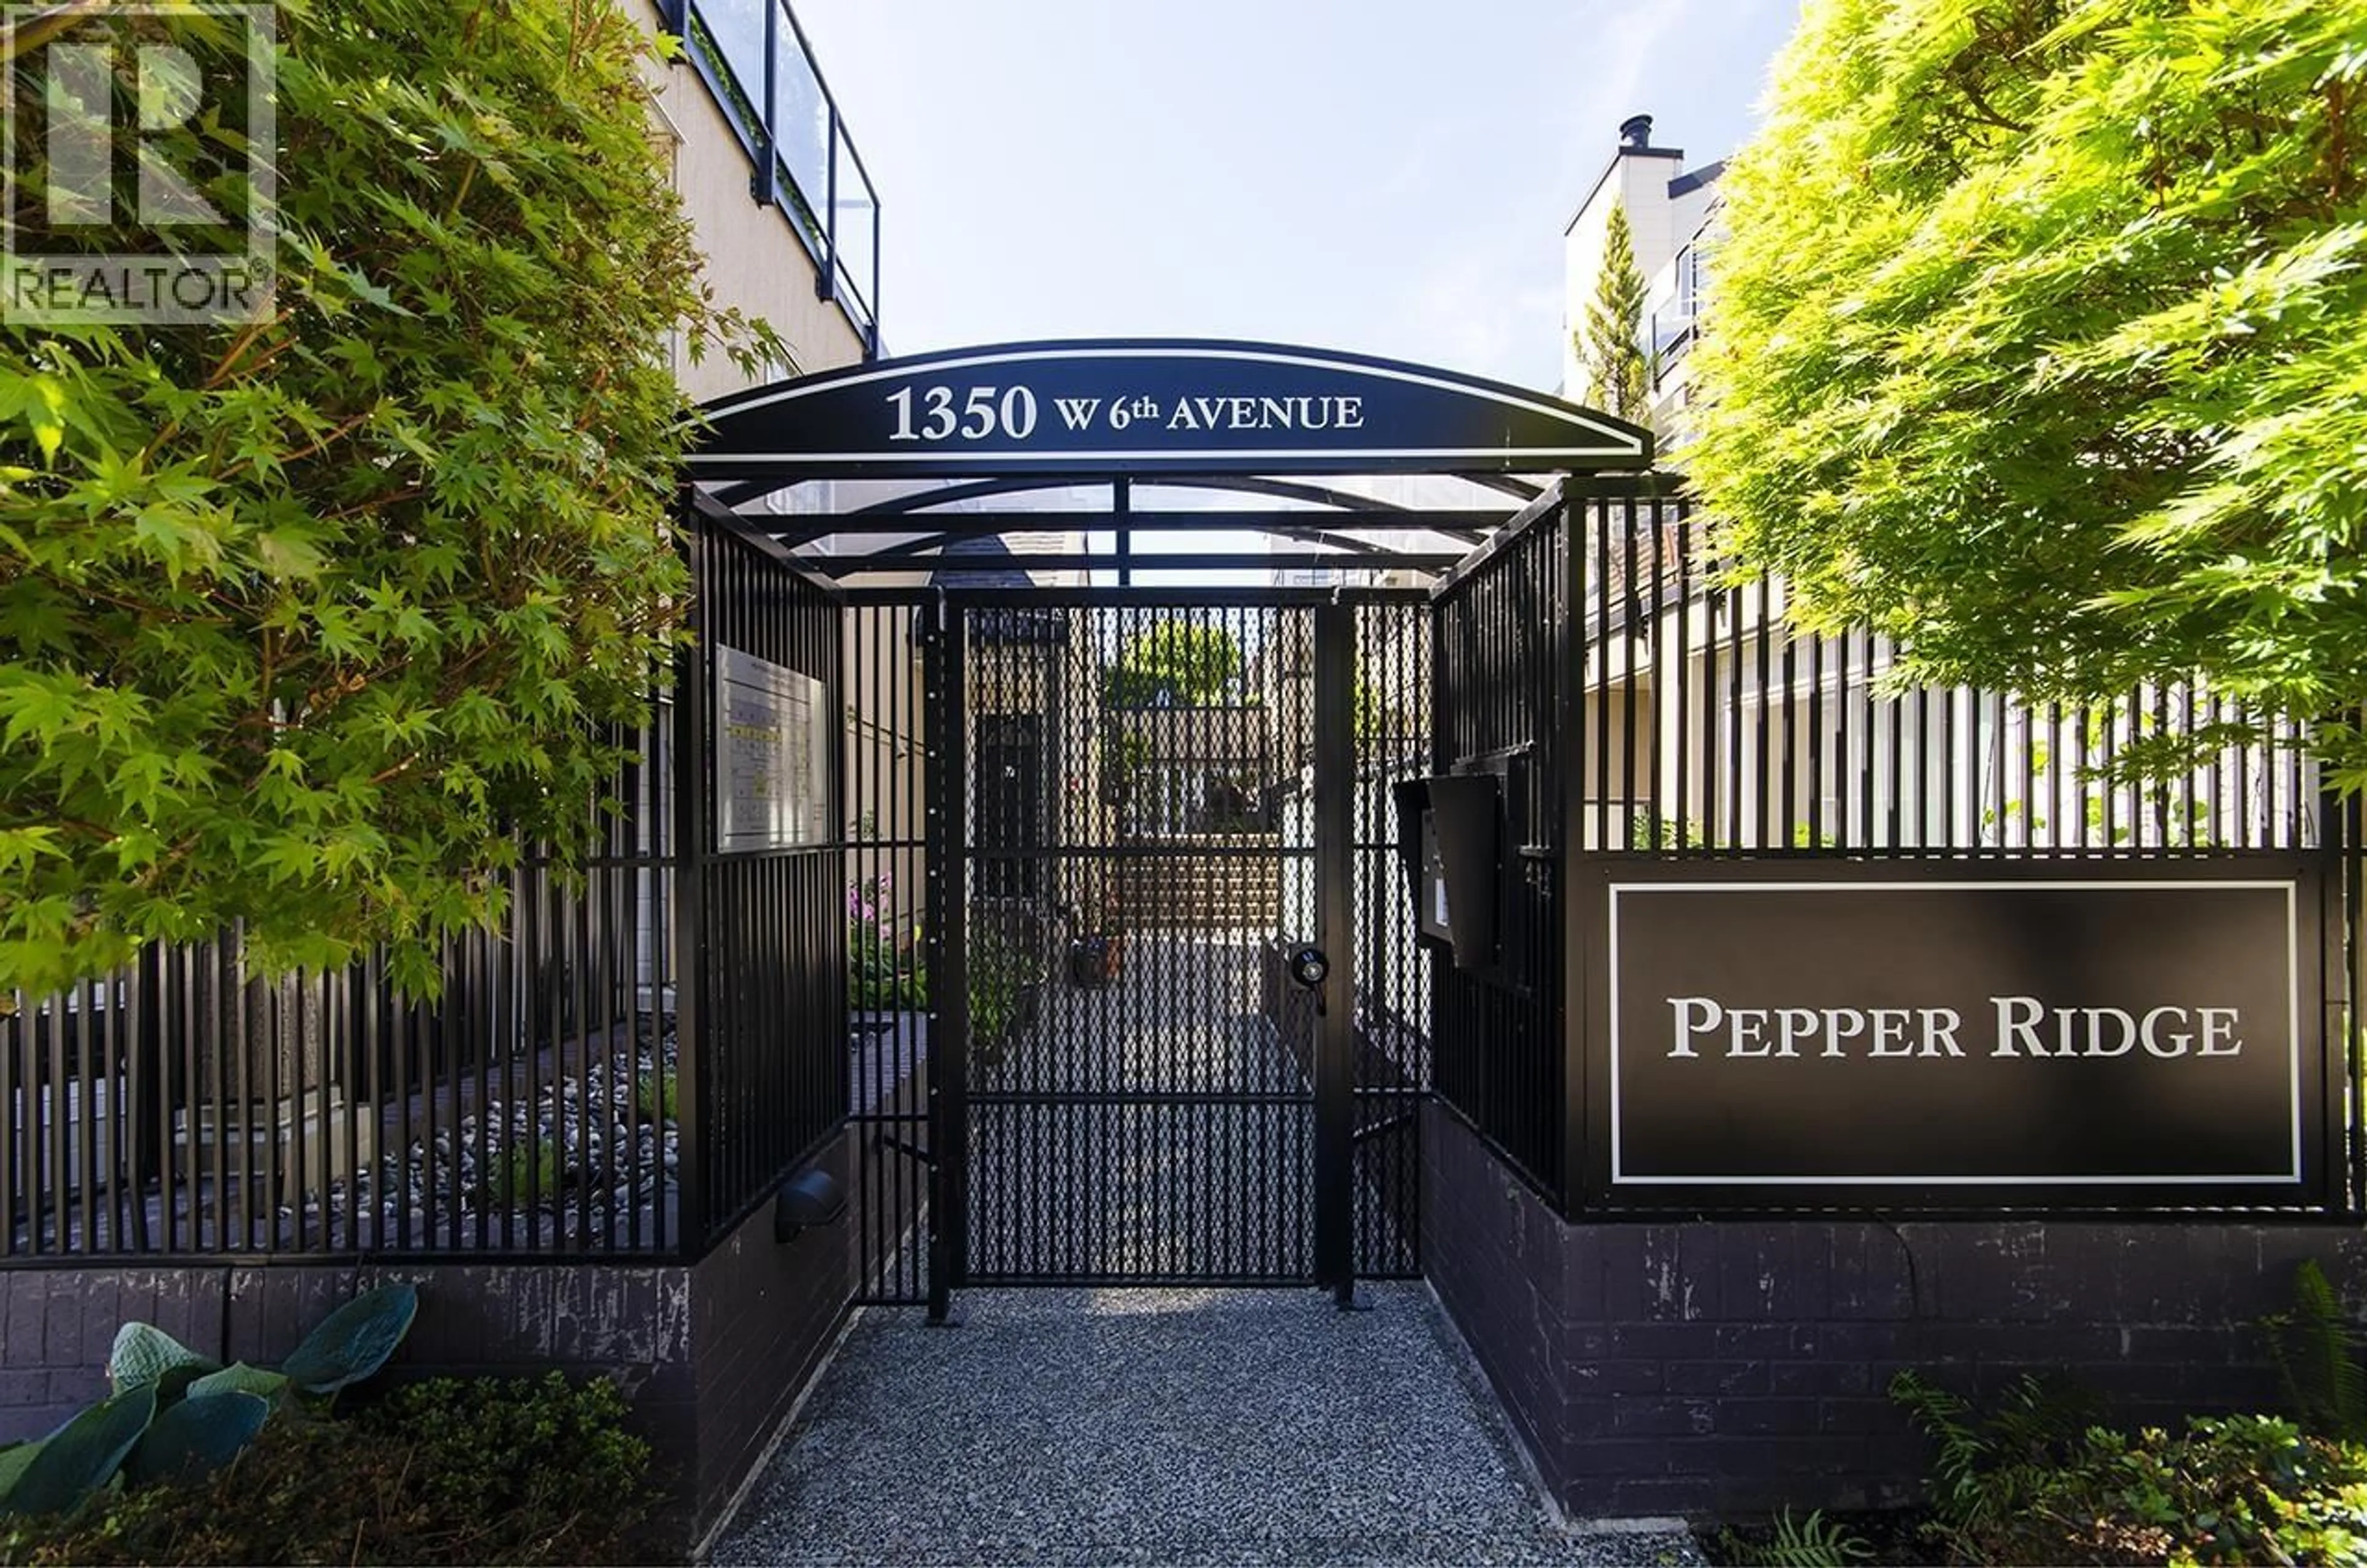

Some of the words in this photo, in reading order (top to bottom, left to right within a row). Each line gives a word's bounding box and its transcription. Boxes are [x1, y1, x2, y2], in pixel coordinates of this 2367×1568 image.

[886, 385, 1037, 440] 1350
[1053, 398, 1102, 430] W
[1109, 395, 1160, 430] 6th
[1166, 396, 1364, 430] AVENUE
[1666, 997, 1967, 1058] PEPPER
[1989, 997, 2242, 1058] RIDGE
